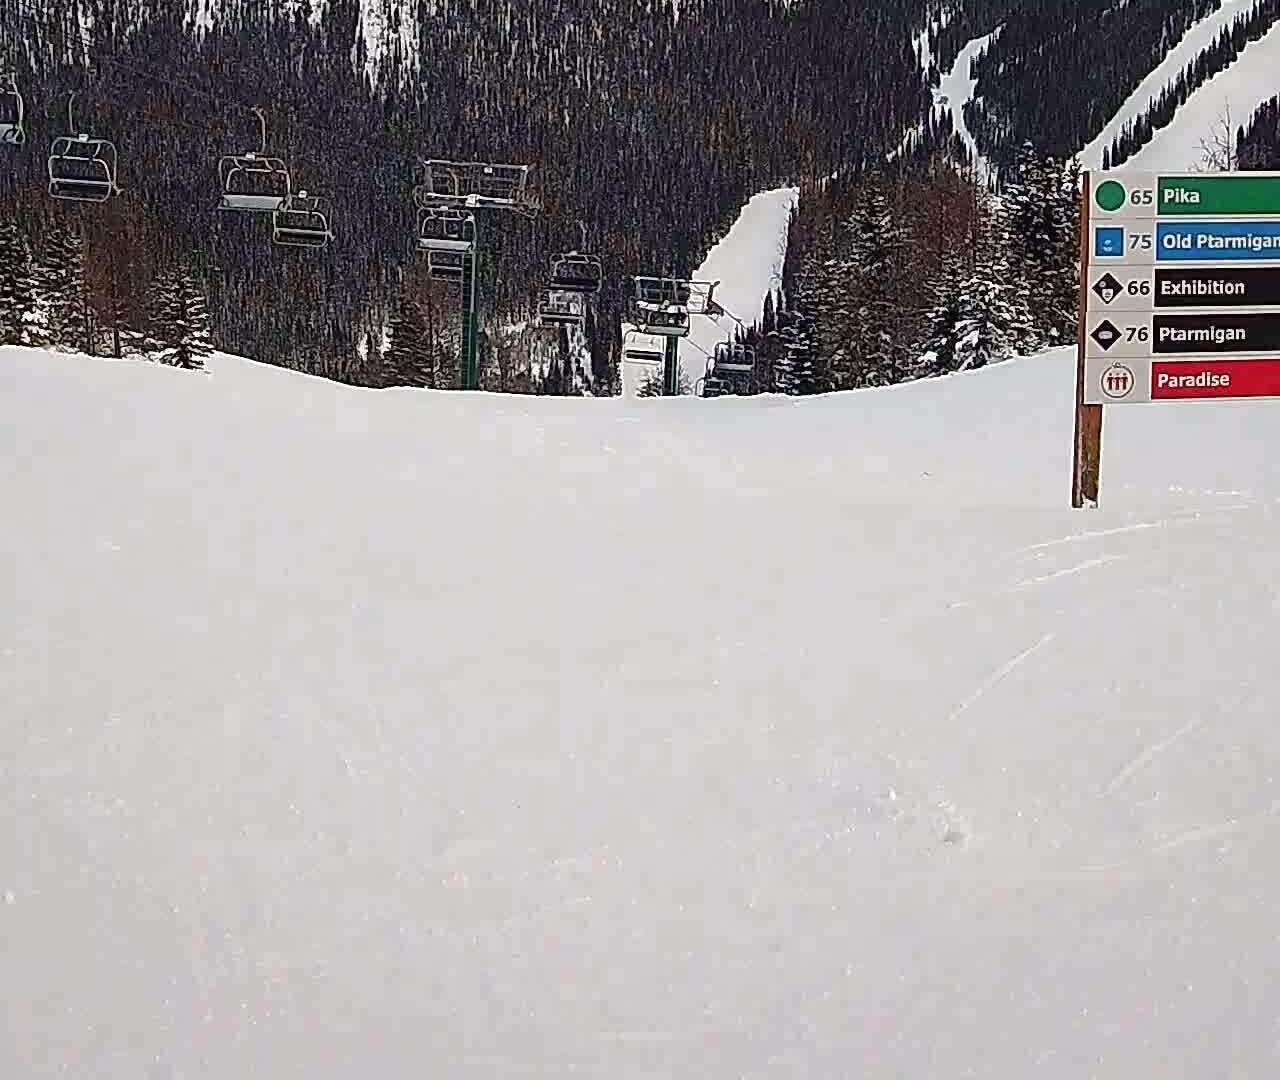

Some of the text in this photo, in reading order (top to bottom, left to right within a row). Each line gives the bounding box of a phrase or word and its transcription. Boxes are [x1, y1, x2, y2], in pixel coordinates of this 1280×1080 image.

[1130, 188, 1200, 205] 65 Pika
[1129, 234, 1152, 249] 75
[1163, 234, 1191, 249] Old
[1128, 280, 1245, 296] 66 Exhibition
[1126, 326, 1246, 344] 76 Ptarmigan
[1158, 372, 1230, 388] Paradise
